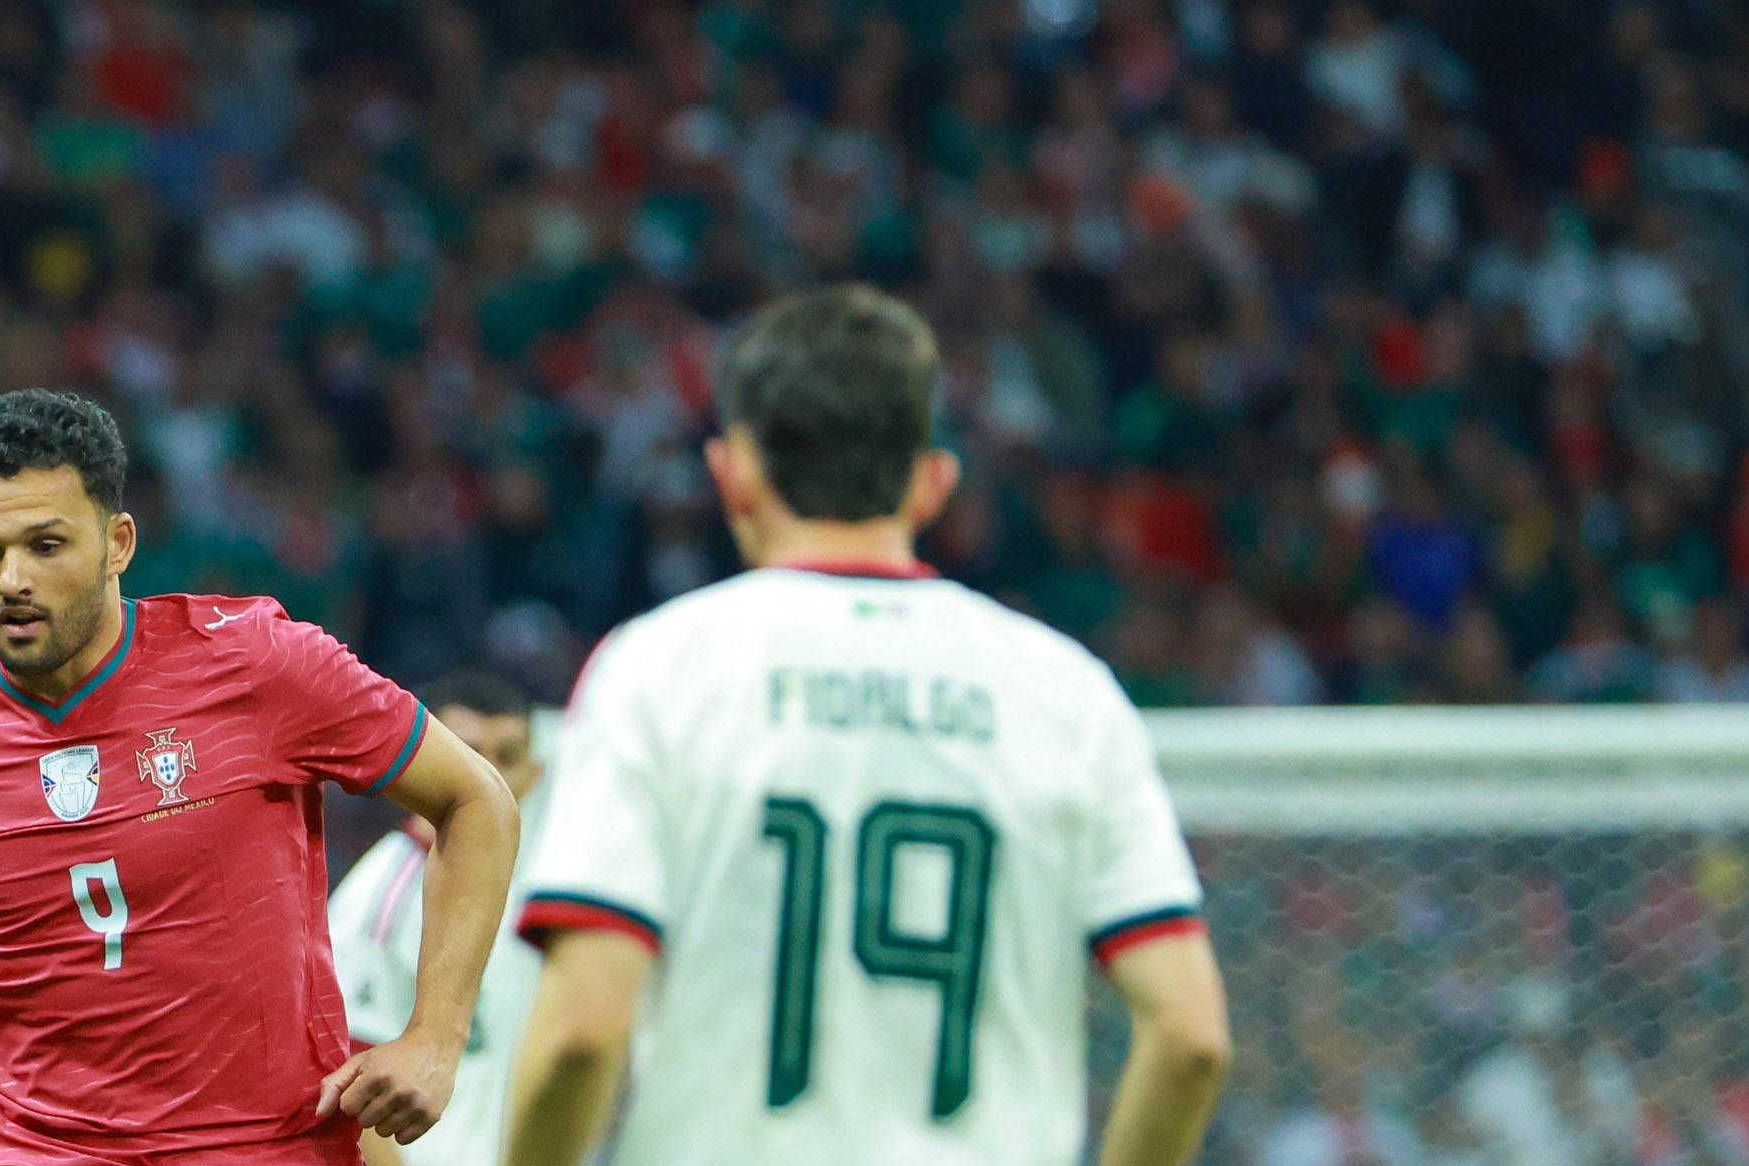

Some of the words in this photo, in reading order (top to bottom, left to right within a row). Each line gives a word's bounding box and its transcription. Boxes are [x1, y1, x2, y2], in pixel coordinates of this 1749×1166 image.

[765, 663, 998, 746] FIDALGO
[68, 857, 129, 970] 9
[762, 795, 997, 1122] 19
